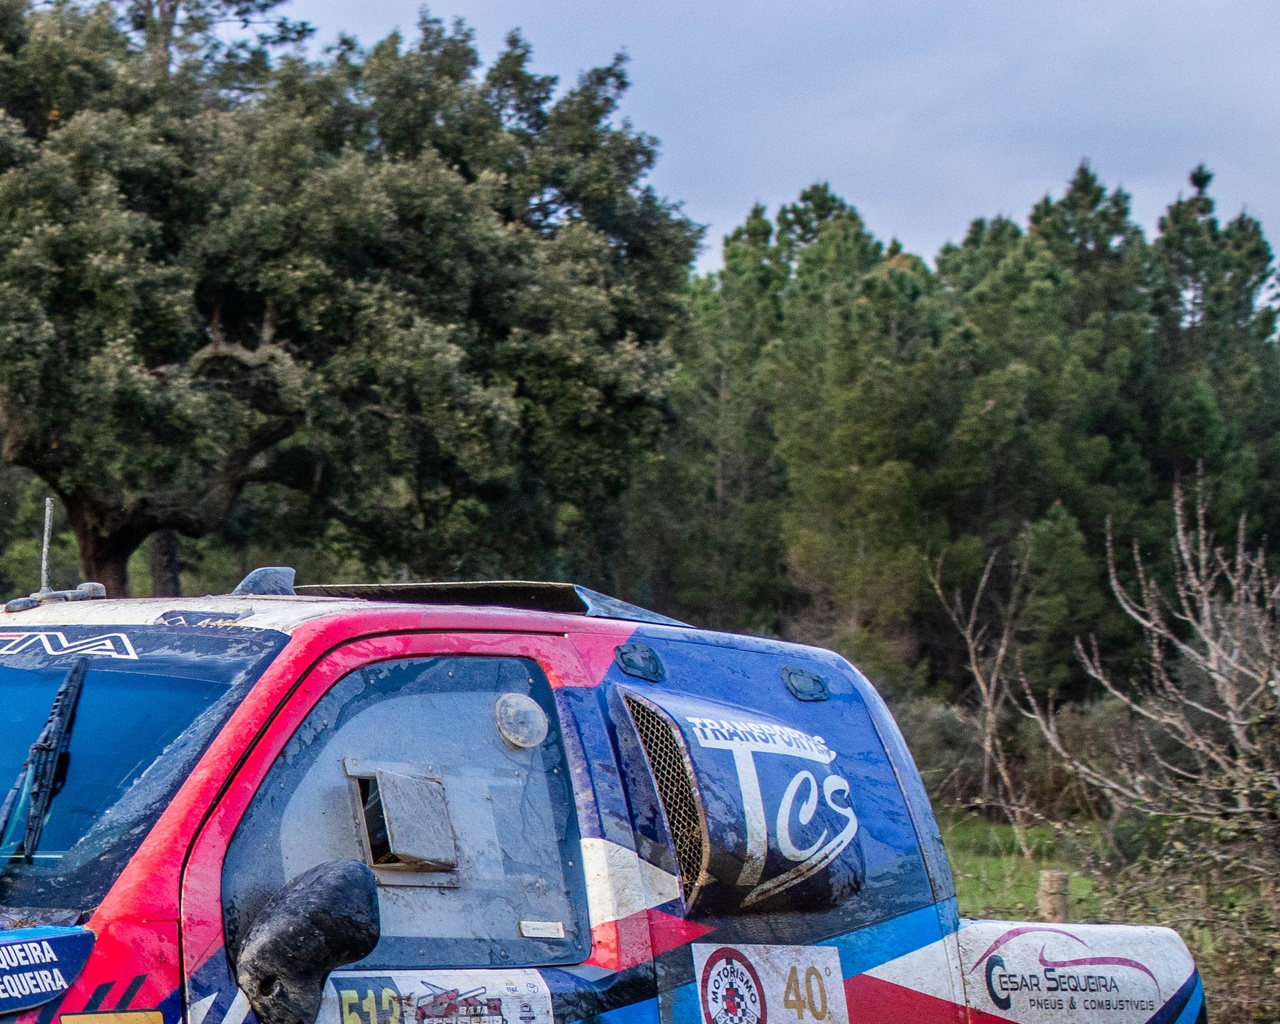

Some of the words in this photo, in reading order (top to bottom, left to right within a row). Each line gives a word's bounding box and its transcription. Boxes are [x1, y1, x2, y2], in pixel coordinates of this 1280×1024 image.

[685, 716, 828, 755] TRANSPORTES
[711, 966, 757, 1004] MOTORISMO
[1044, 968, 1120, 993] SEQUEIRA
[1029, 999, 1064, 1010] PNEUS
[1069, 997, 1077, 1010] &
